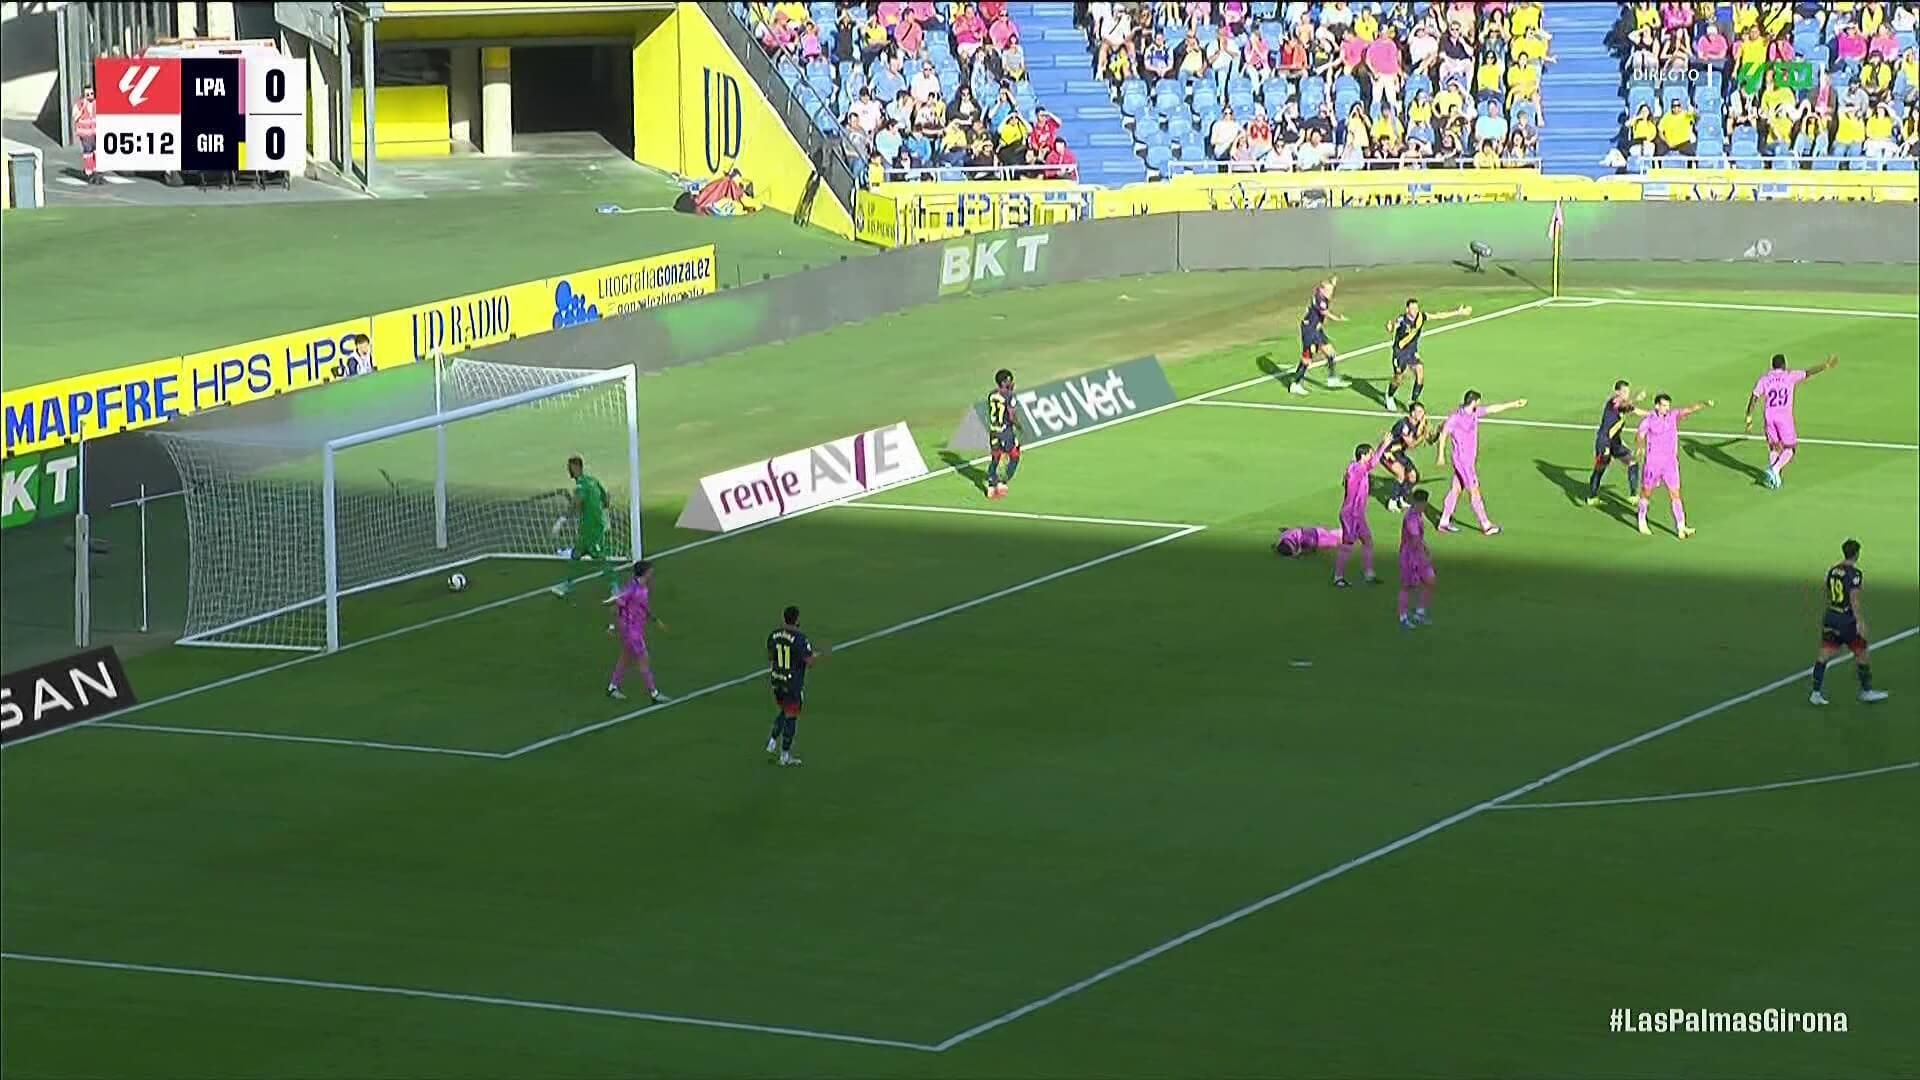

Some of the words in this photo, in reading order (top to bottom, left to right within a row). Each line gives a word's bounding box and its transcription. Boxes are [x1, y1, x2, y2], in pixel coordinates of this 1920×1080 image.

[703, 66, 742, 175] UD
[942, 233, 1049, 285] BKT
[412, 310, 444, 361] UD
[451, 295, 510, 345] RADIO
[193, 353, 272, 403] HPS
[1016, 390, 1078, 437] Feu
[1065, 369, 1136, 420] Vert
[1768, 387, 1788, 408] 29
[5, 374, 180, 449] MAPFRE
[2, 456, 77, 517] KT
[719, 457, 801, 516] renfe
[810, 424, 900, 492] AVE
[1830, 577, 1844, 602] 19
[776, 643, 791, 670] 11
